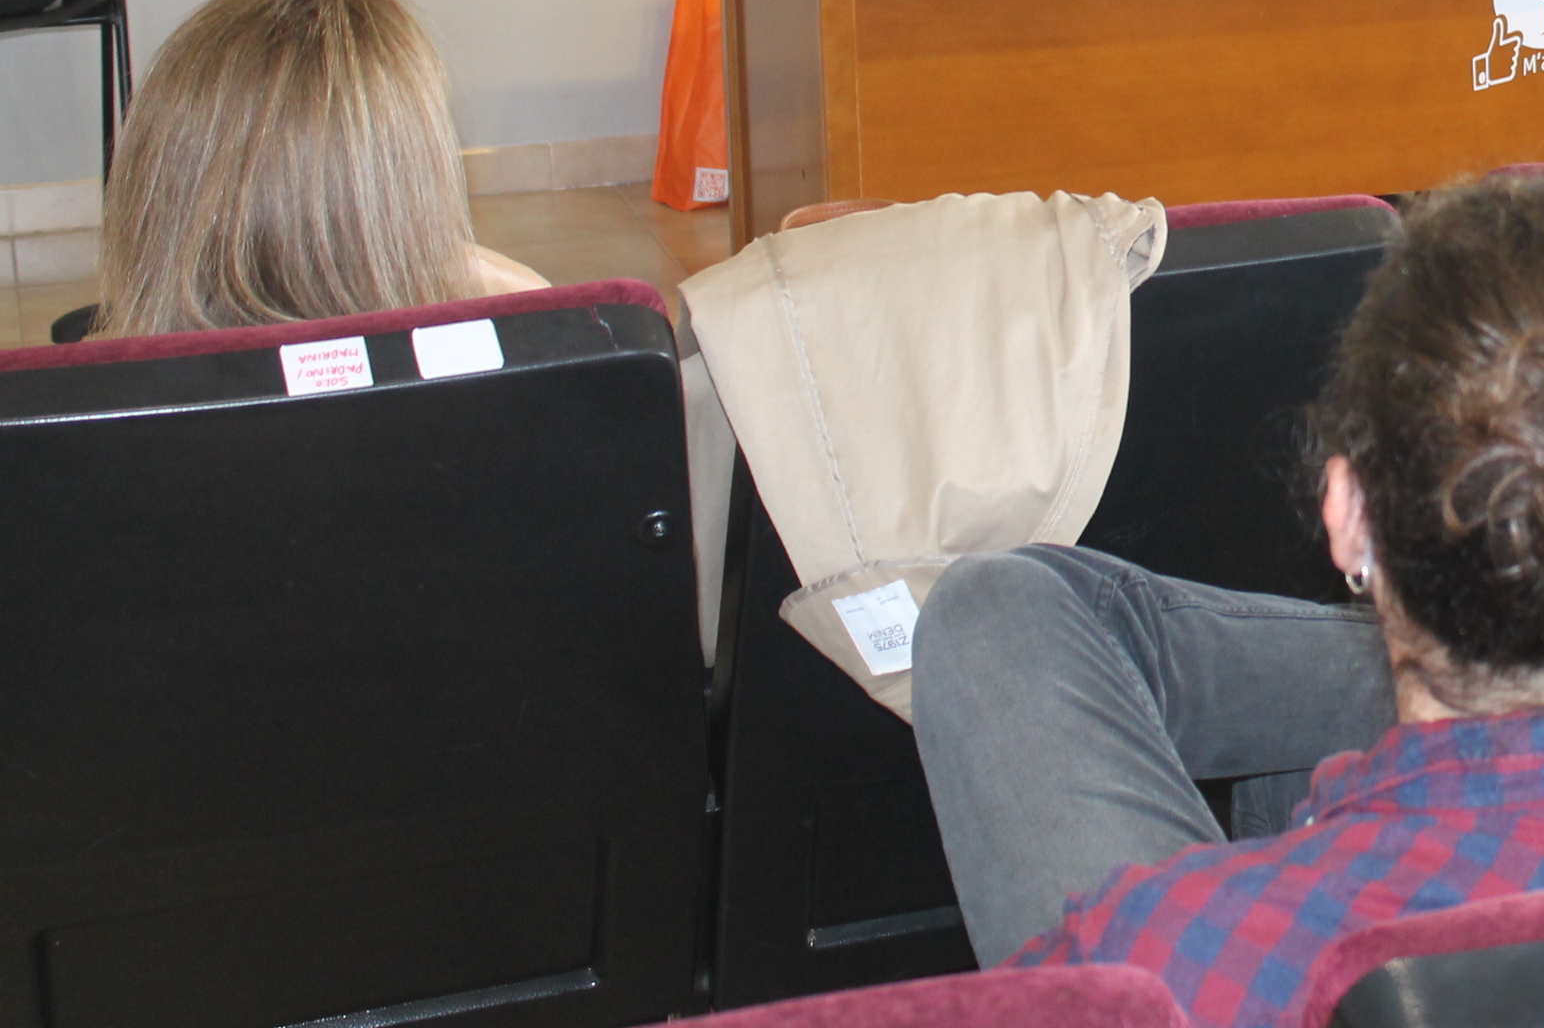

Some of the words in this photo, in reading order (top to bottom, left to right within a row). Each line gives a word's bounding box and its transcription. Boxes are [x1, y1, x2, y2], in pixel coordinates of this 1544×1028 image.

[299, 348, 359, 364] MADRINA
[316, 377, 348, 387] SOLO
[866, 623, 904, 640] DENIM
[873, 635, 910, 652] Z1975
